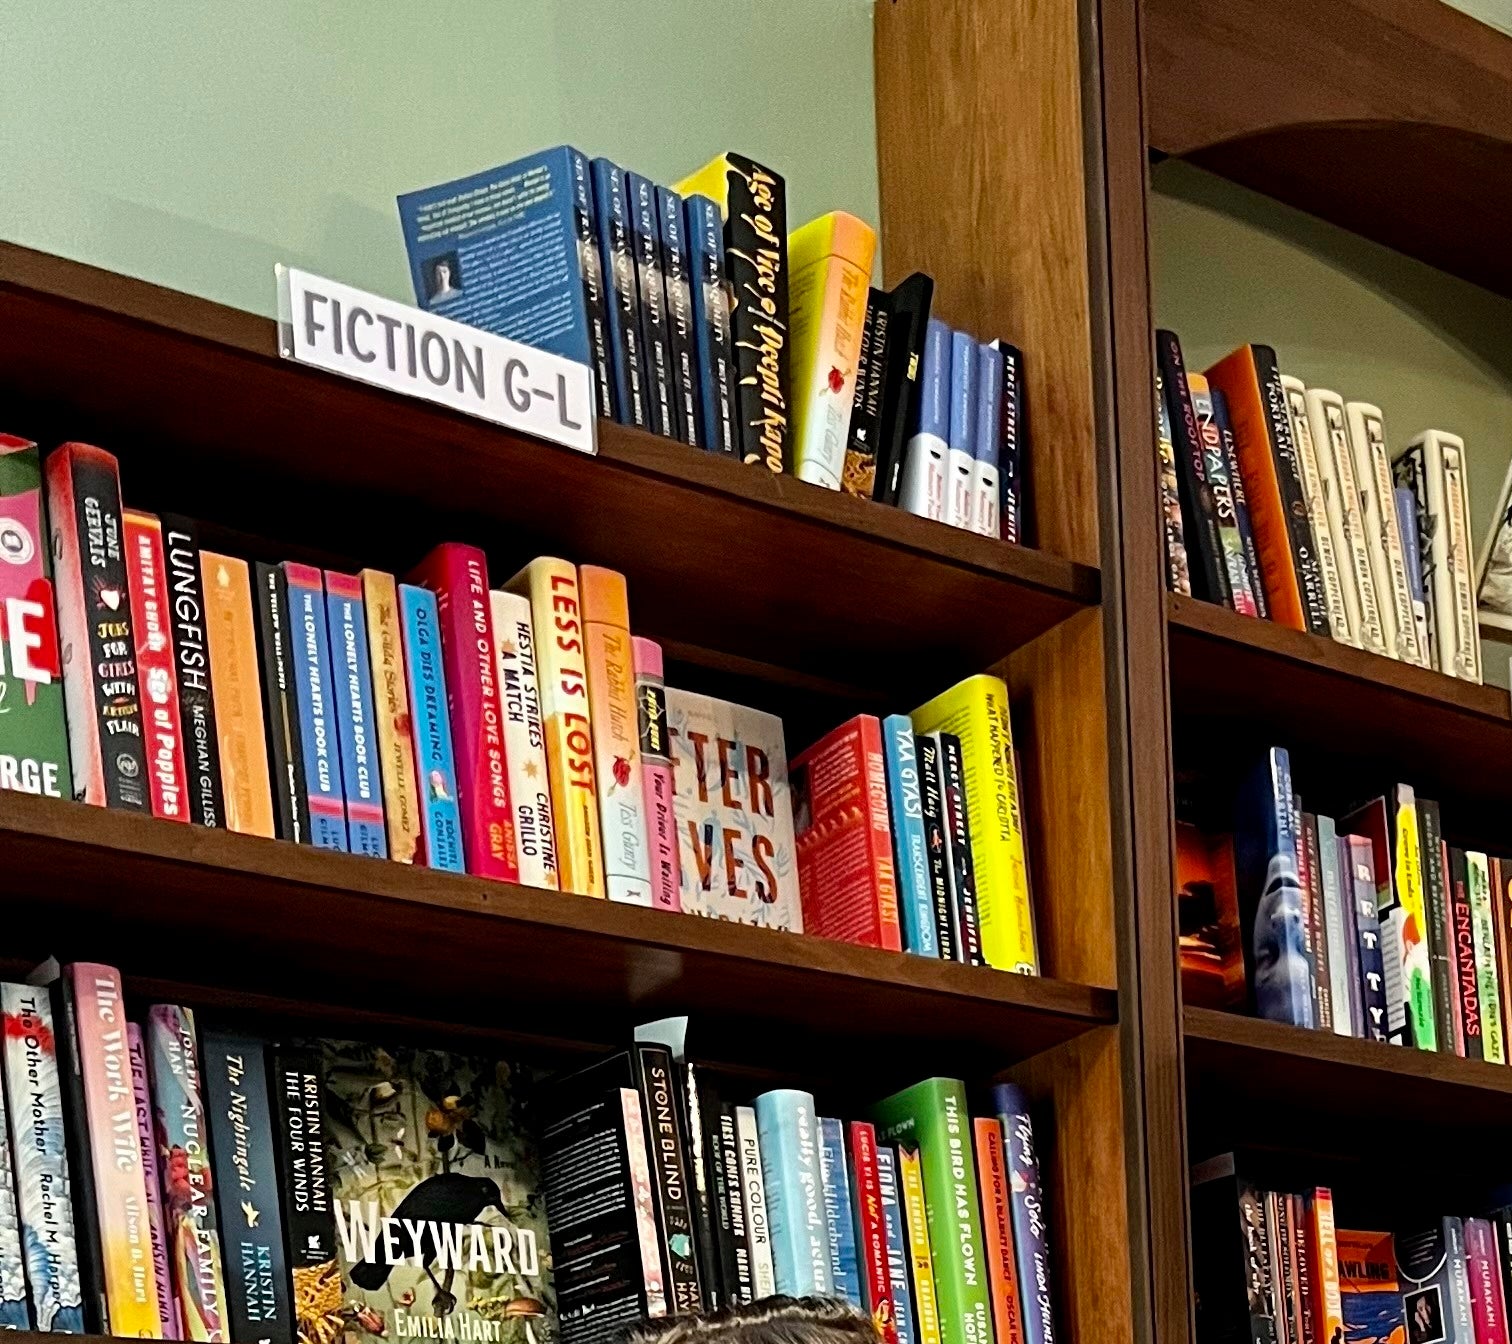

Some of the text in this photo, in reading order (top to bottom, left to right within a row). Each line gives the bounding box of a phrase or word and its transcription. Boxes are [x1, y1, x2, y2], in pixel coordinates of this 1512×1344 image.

[302, 289, 581, 431] FICTION G-L
[1267, 381, 1289, 460] PORTRAIT
[1195, 399, 1235, 520] ENDPAPERS
[167, 531, 207, 691] LUNGFISH
[468, 560, 506, 809] LIFE AND OTHER LOVE SONGS
[517, 621, 542, 749] HESTIA STRIKES
[551, 575, 595, 796] LESS IS LOST
[518, 805, 537, 856] GRILLO
[1456, 902, 1480, 1037] ENCANTADAS
[20, 997, 55, 1226] The Other Mother Rachel
[95, 975, 140, 1175] The Work Wife
[651, 1067, 682, 1200] STONE BLIND
[180, 1104, 218, 1310] NUCLEAR FAMILY
[303, 1074, 329, 1214] KRISTIN HANNAH
[743, 1138, 767, 1245] PURE COLOUR
[944, 1095, 978, 1286] THIS BIRD HAS FLOWN
[240, 1241, 263, 1323] HANNAH
[256, 1245, 278, 1320] KRISTIN
[333, 1198, 540, 1278] WEYWARD
[821, 1179, 847, 1278] Hilderbrand
[394, 1309, 502, 1343] EMILIA HART
[1480, 1260, 1497, 1328] MURAKAMI
